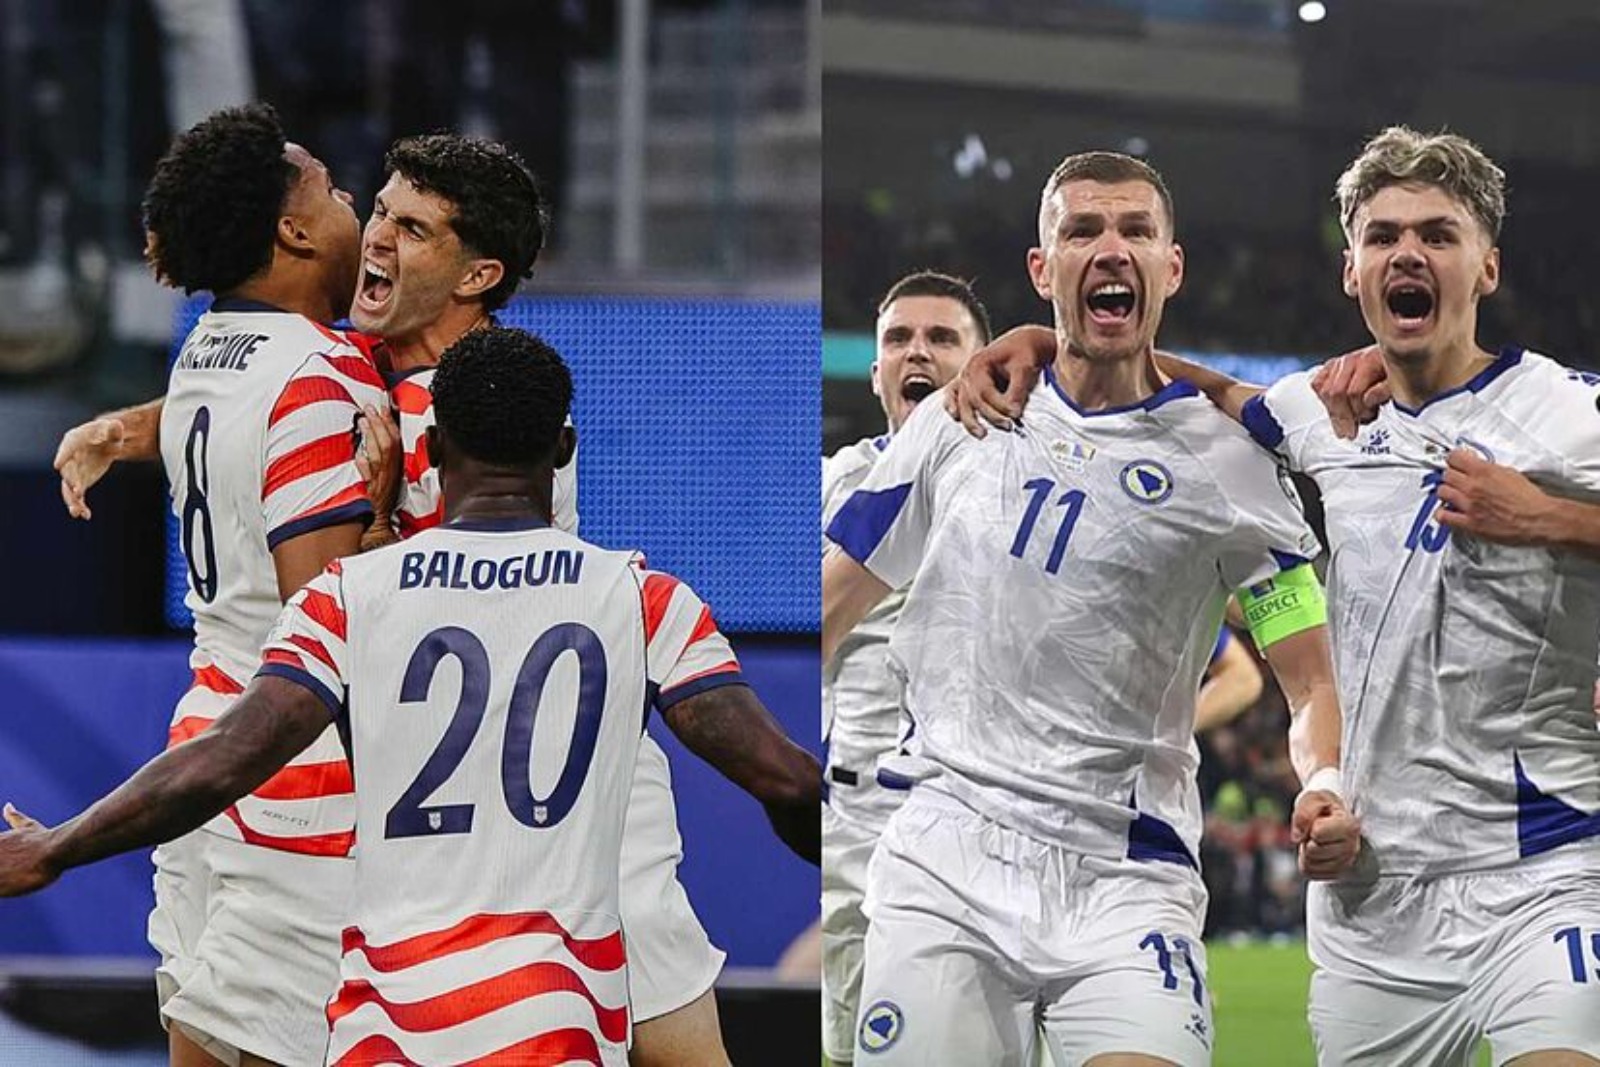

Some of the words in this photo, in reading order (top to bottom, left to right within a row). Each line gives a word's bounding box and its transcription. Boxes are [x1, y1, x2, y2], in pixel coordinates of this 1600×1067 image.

[183, 405, 218, 603] 8
[1010, 477, 1086, 575] 11
[399, 550, 584, 590] BALOGUN
[1248, 593, 1299, 622] RESPECT
[384, 622, 607, 839] 20
[1139, 931, 1203, 1006] 11
[1553, 926, 1600, 984] 1
